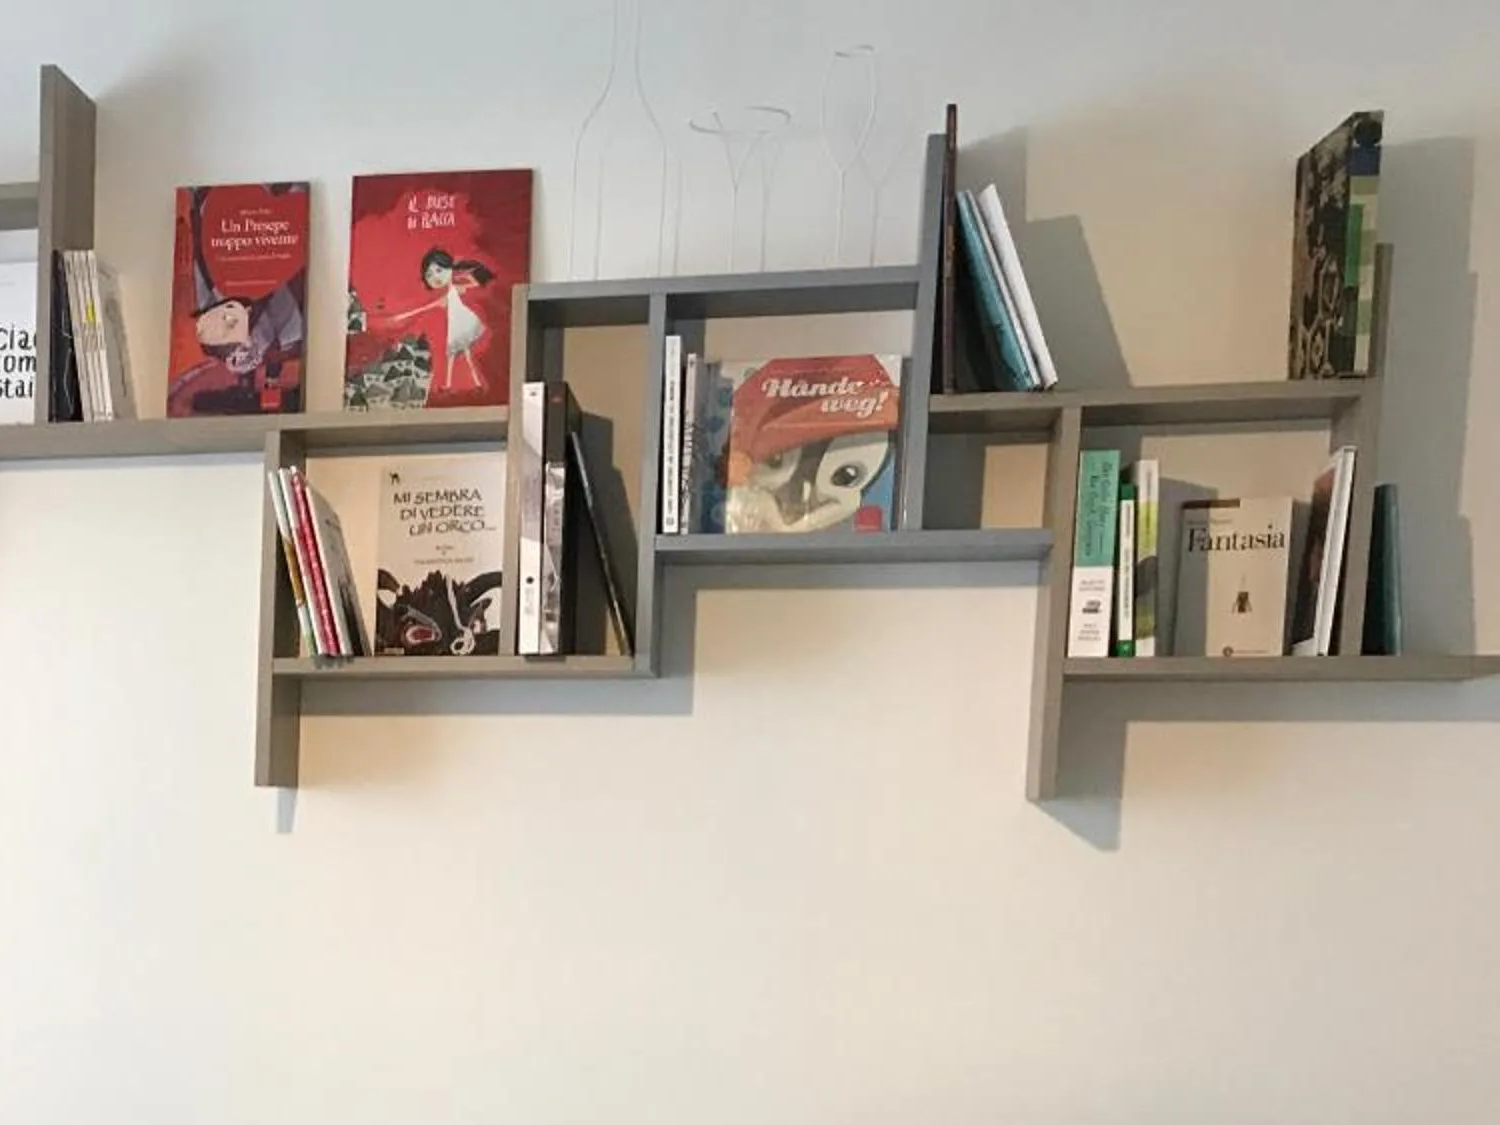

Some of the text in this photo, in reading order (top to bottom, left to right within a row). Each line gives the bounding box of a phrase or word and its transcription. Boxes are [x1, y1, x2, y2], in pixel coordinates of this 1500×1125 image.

[220, 217, 290, 236] Un Presepe
[211, 232, 299, 251] troppo vivente
[393, 488, 483, 505] MI SEMBRA
[400, 504, 485, 521] DI VEDERE
[409, 521, 434, 537] UN
[1187, 525, 1286, 553] Fantasia
